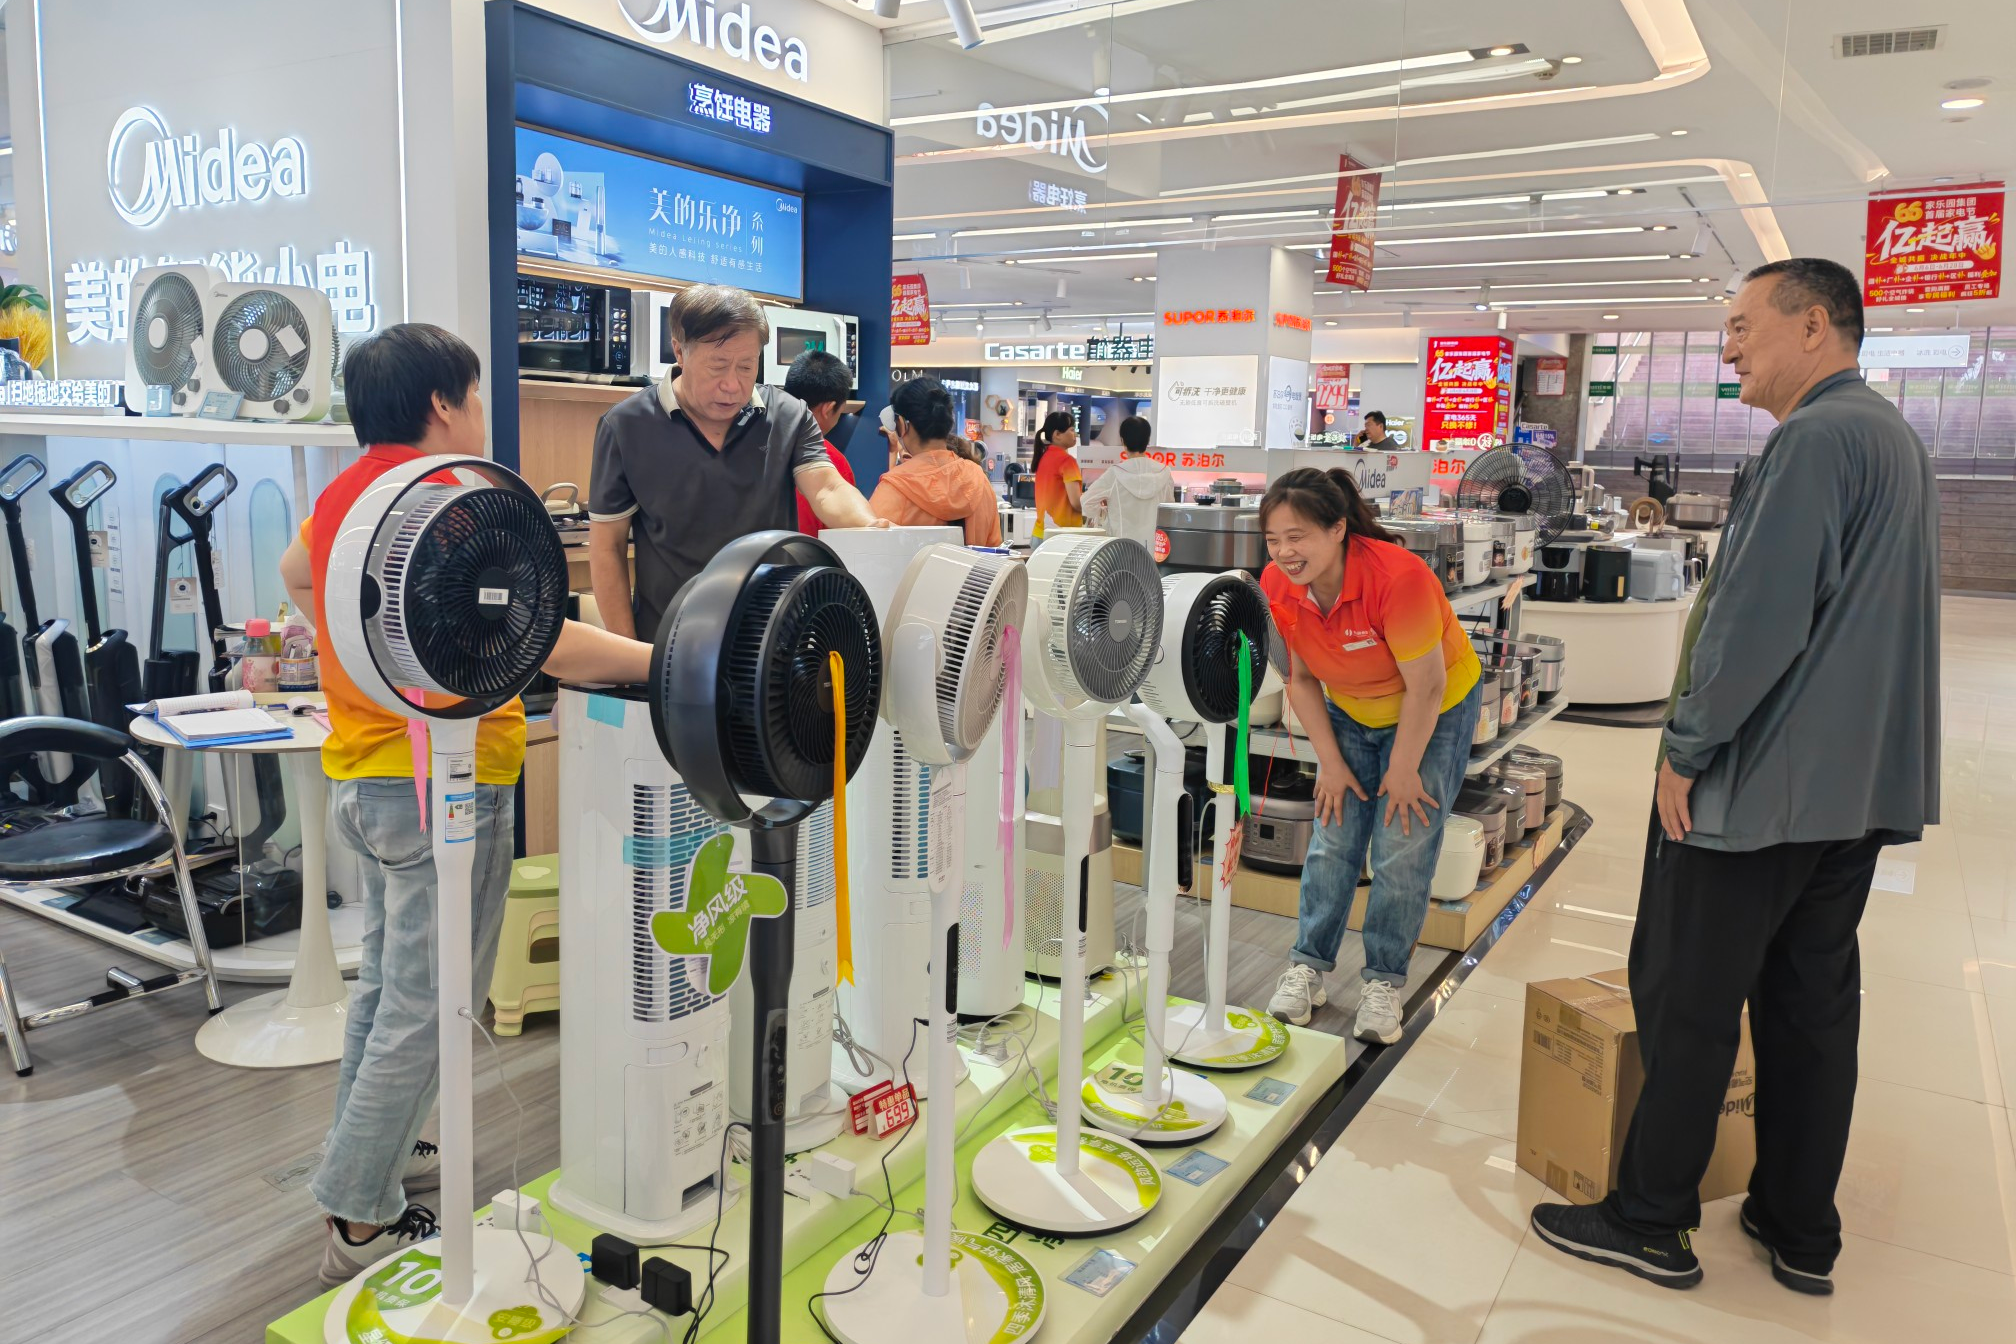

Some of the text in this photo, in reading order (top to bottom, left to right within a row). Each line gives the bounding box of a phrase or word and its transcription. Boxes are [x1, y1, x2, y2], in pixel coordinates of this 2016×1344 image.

[619, 0, 808, 82] Midea
[690, 83, 771, 132] 烹饪电器
[107, 107, 306, 226] Midea
[648, 187, 742, 238] 美的乐净
[776, 198, 798, 214] Midea
[1895, 201, 1923, 223] 66
[1925, 197, 1977, 210] 家乐园集团
[649, 228, 677, 240] Midea
[715, 242, 742, 253] series
[751, 211, 764, 257] 系列
[1873, 215, 1995, 262] 亿起赢
[649, 243, 762, 273] 美的人感科技 舒适有感生活
[1164, 309, 1256, 326] SUPOR 苏泊尔
[984, 342, 1086, 361] Casarte
[1062, 367, 1083, 381] Haier
[1429, 358, 1494, 384] 亿起赢
[11, 380, 111, 403] 扫地拖地交给美的
[1175, 386, 1247, 397] 可拆洗 干净更健康
[1317, 385, 1347, 408] 2299
[1119, 449, 1225, 468] SOR 苏泊尔
[1354, 458, 1386, 492] Midea
[688, 874, 748, 946] 净风级
[1109, 1067, 1144, 1086] 10
[878, 1088, 911, 1112] 特惠单品
[1716, 1092, 1756, 1118] Mide
[886, 1101, 909, 1128] 699
[382, 1261, 442, 1295] 10
[1003, 1275, 1038, 1336] 四季沐清风
